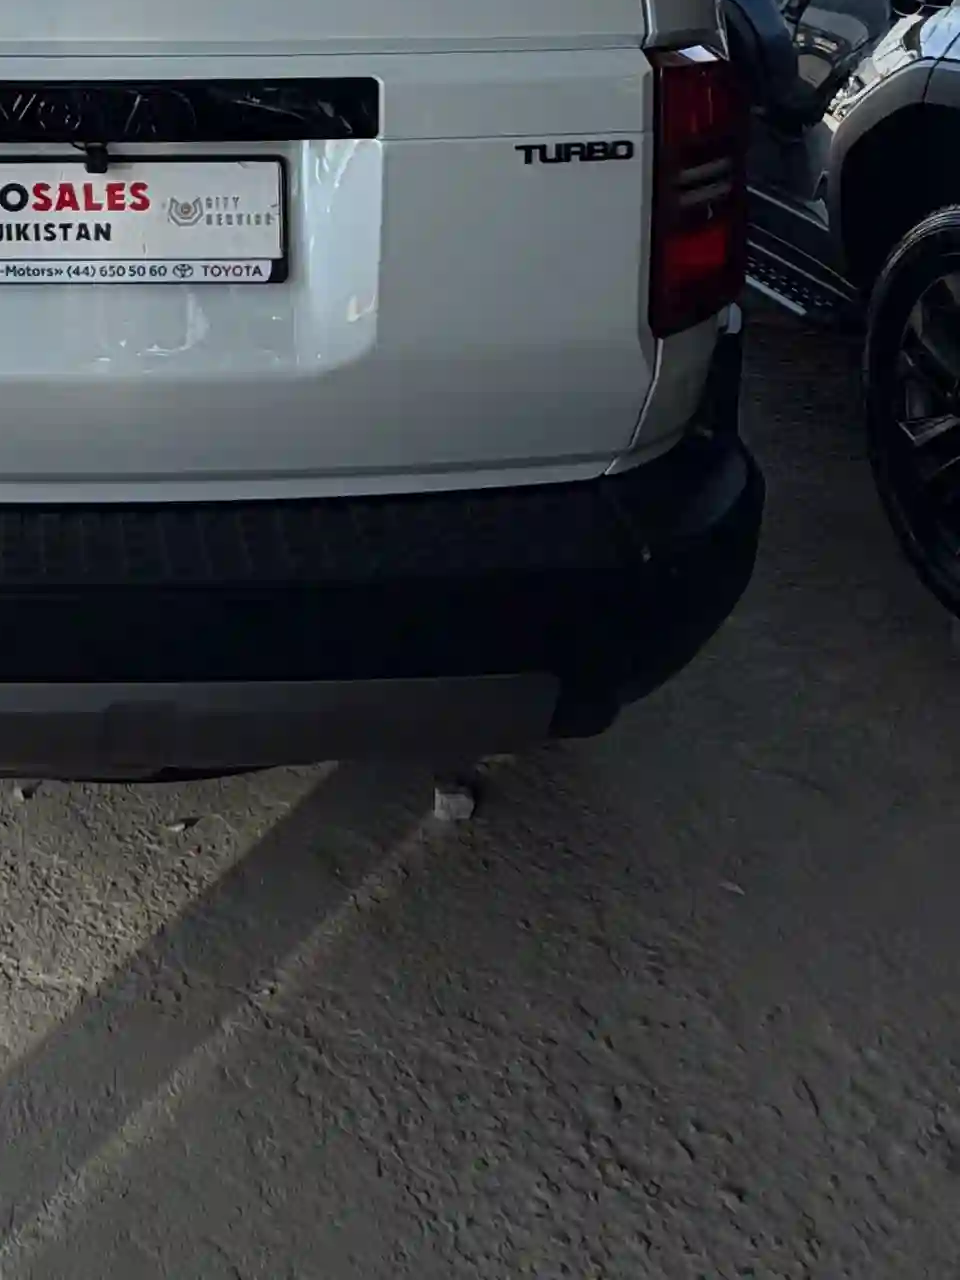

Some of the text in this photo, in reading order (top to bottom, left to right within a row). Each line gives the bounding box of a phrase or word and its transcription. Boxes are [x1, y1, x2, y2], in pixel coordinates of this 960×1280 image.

[515, 140, 634, 165] TURBO
[67, 264, 96, 278] (44)
[99, 264, 127, 277] 650
[129, 264, 146, 277] 50
[148, 264, 167, 277] 60
[201, 264, 264, 277] TOYOTA
